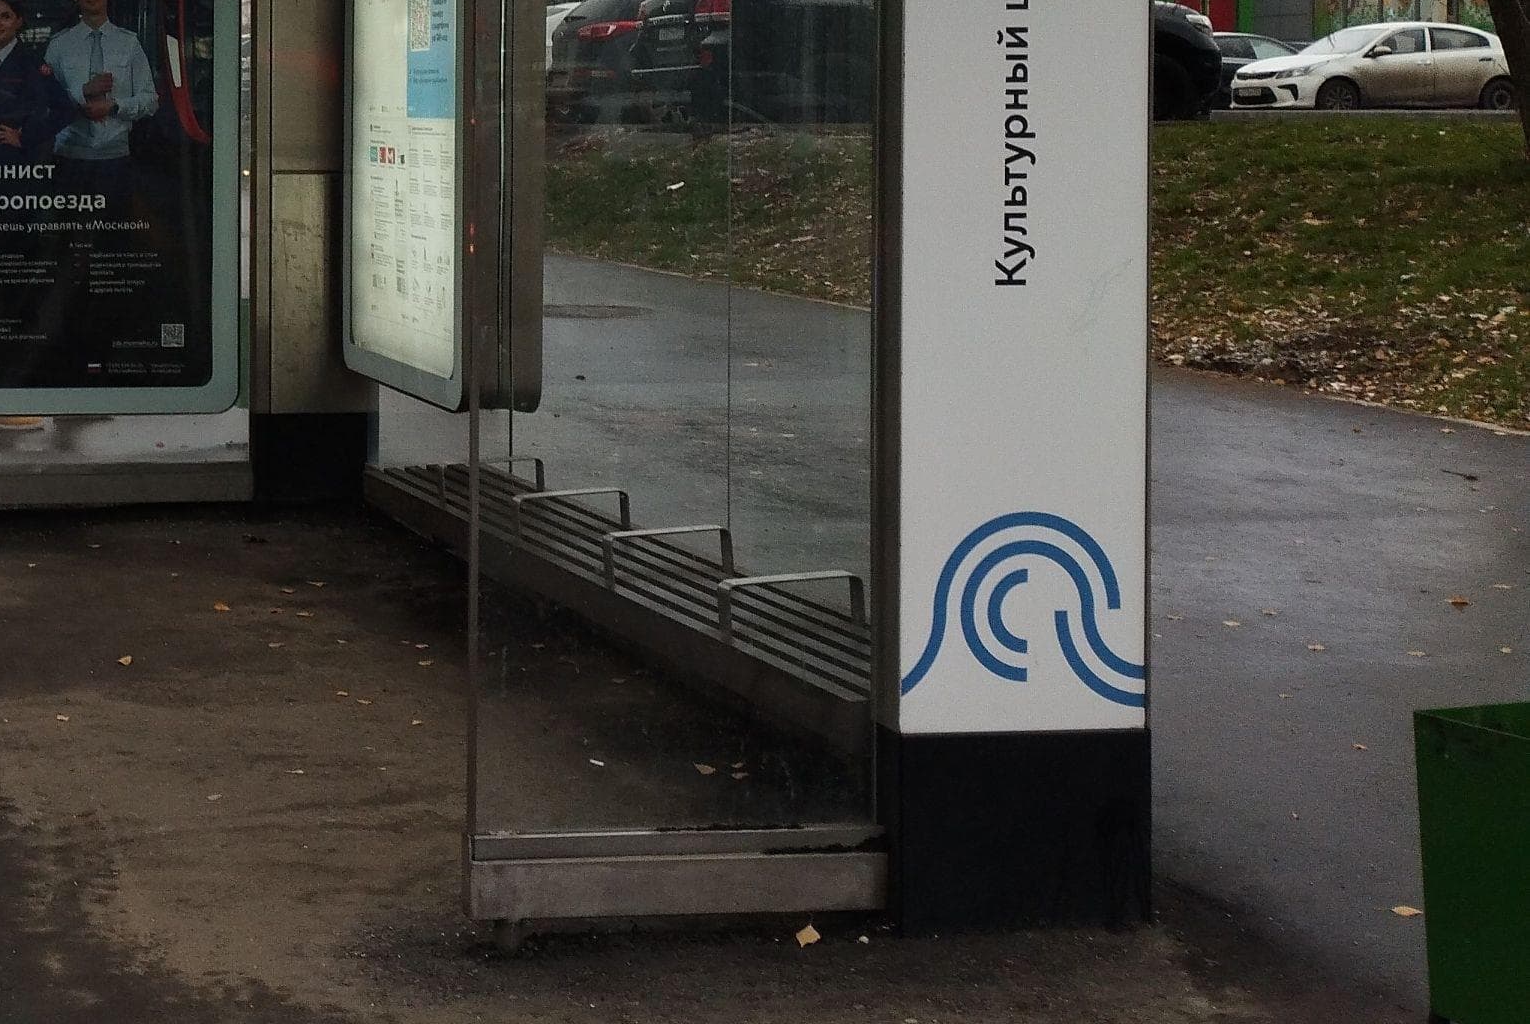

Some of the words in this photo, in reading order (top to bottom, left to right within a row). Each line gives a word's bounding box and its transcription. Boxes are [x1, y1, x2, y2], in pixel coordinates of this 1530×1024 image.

[994, 26, 1036, 286] Культурный
[26, 222, 83, 234] управлять
[85, 219, 151, 232] «Москвой»
